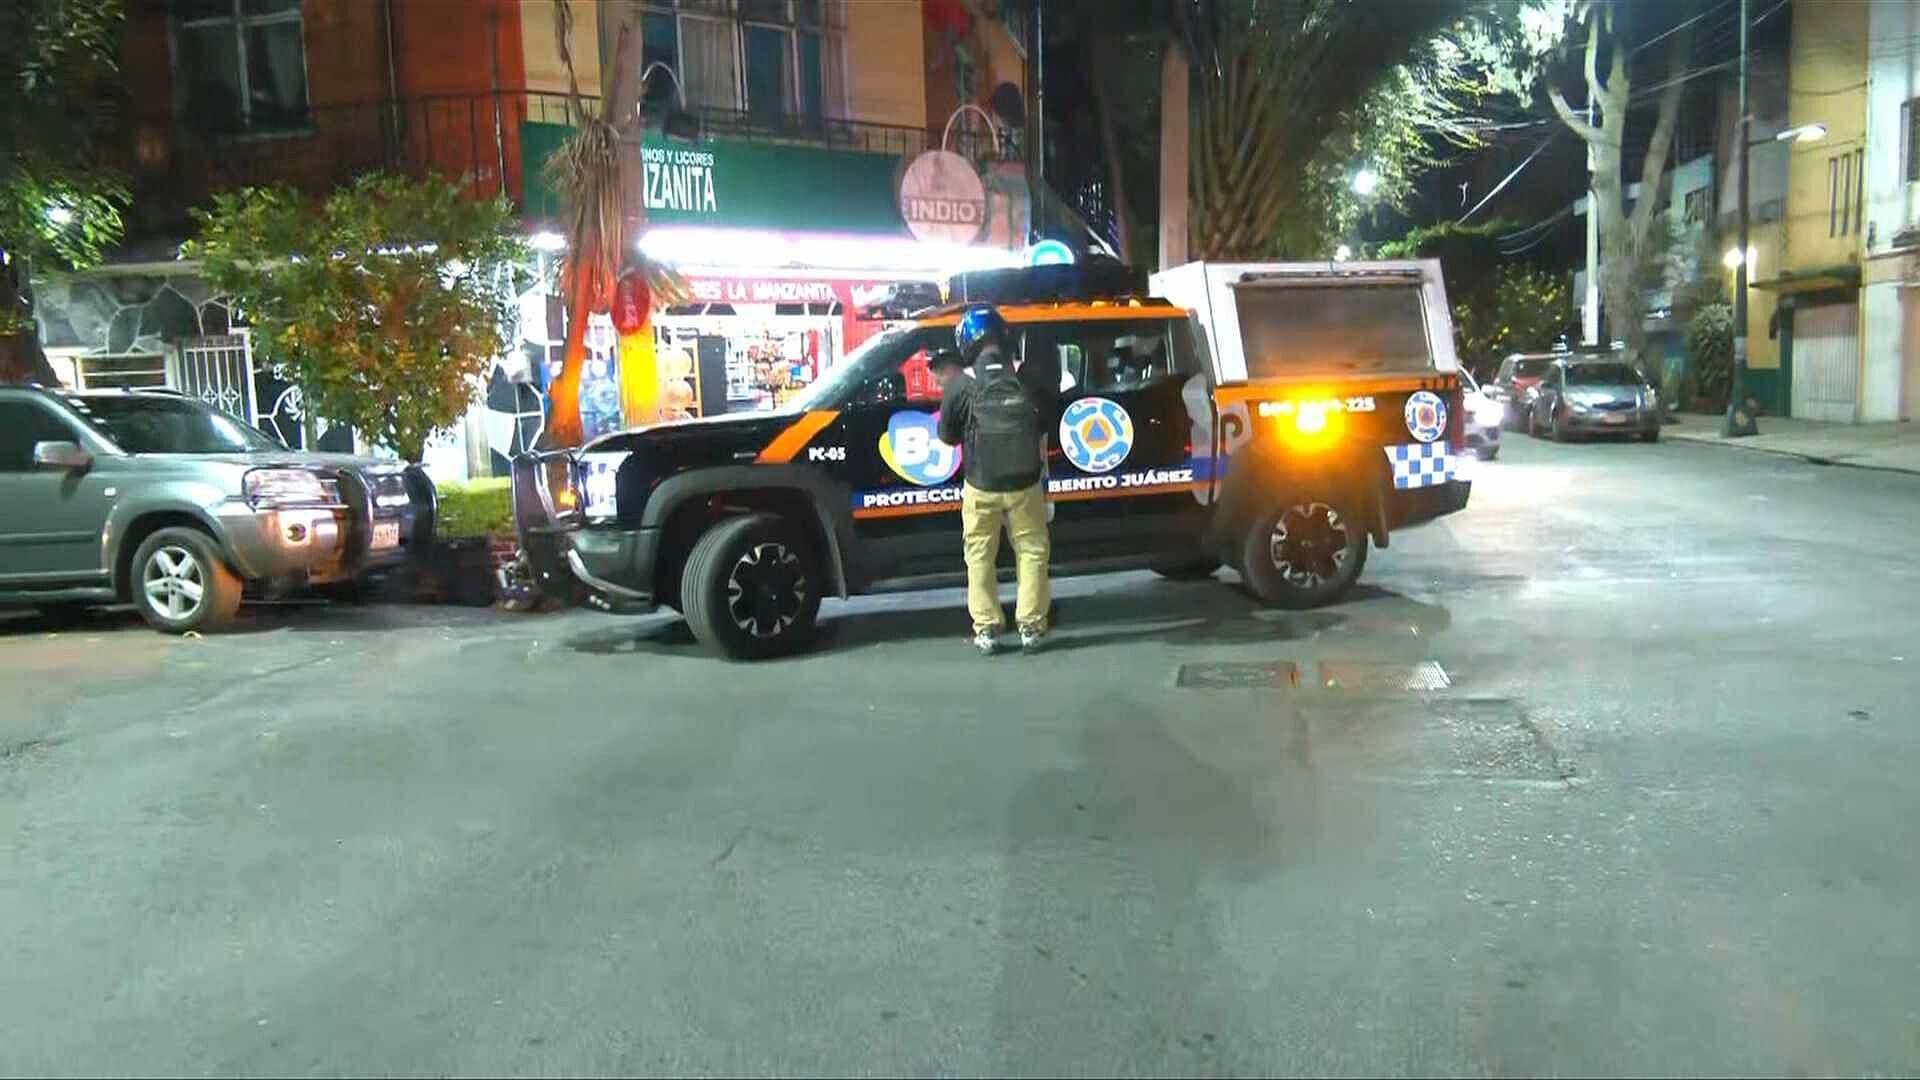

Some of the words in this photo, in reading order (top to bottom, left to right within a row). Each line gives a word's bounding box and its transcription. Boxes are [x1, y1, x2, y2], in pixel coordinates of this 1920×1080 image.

[640, 147, 665, 164] INOS
[666, 149, 673, 164] Y
[911, 199, 976, 222] INDIO
[727, 280, 747, 300] LA
[752, 280, 836, 302] MANZANITA
[808, 447, 846, 461] PC-05
[1048, 475, 1117, 493] BENITO
[1121, 469, 1193, 487] JUÁREZ
